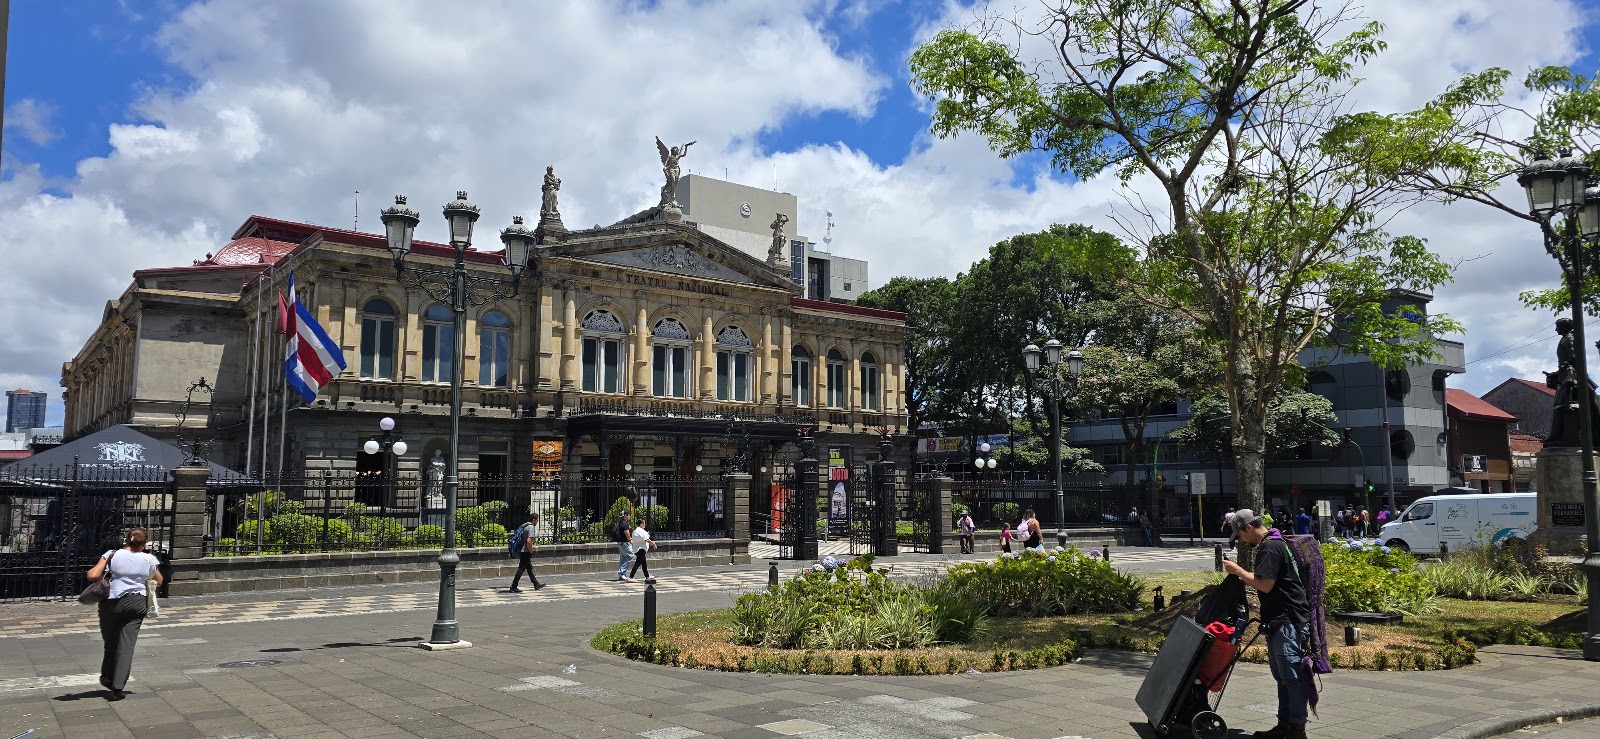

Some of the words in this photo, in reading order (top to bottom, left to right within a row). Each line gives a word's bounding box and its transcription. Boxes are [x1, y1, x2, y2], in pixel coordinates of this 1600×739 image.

[626, 274, 667, 287] TEATRO
[678, 281, 729, 297] NACIONAL
[832, 468, 849, 481] COTO
